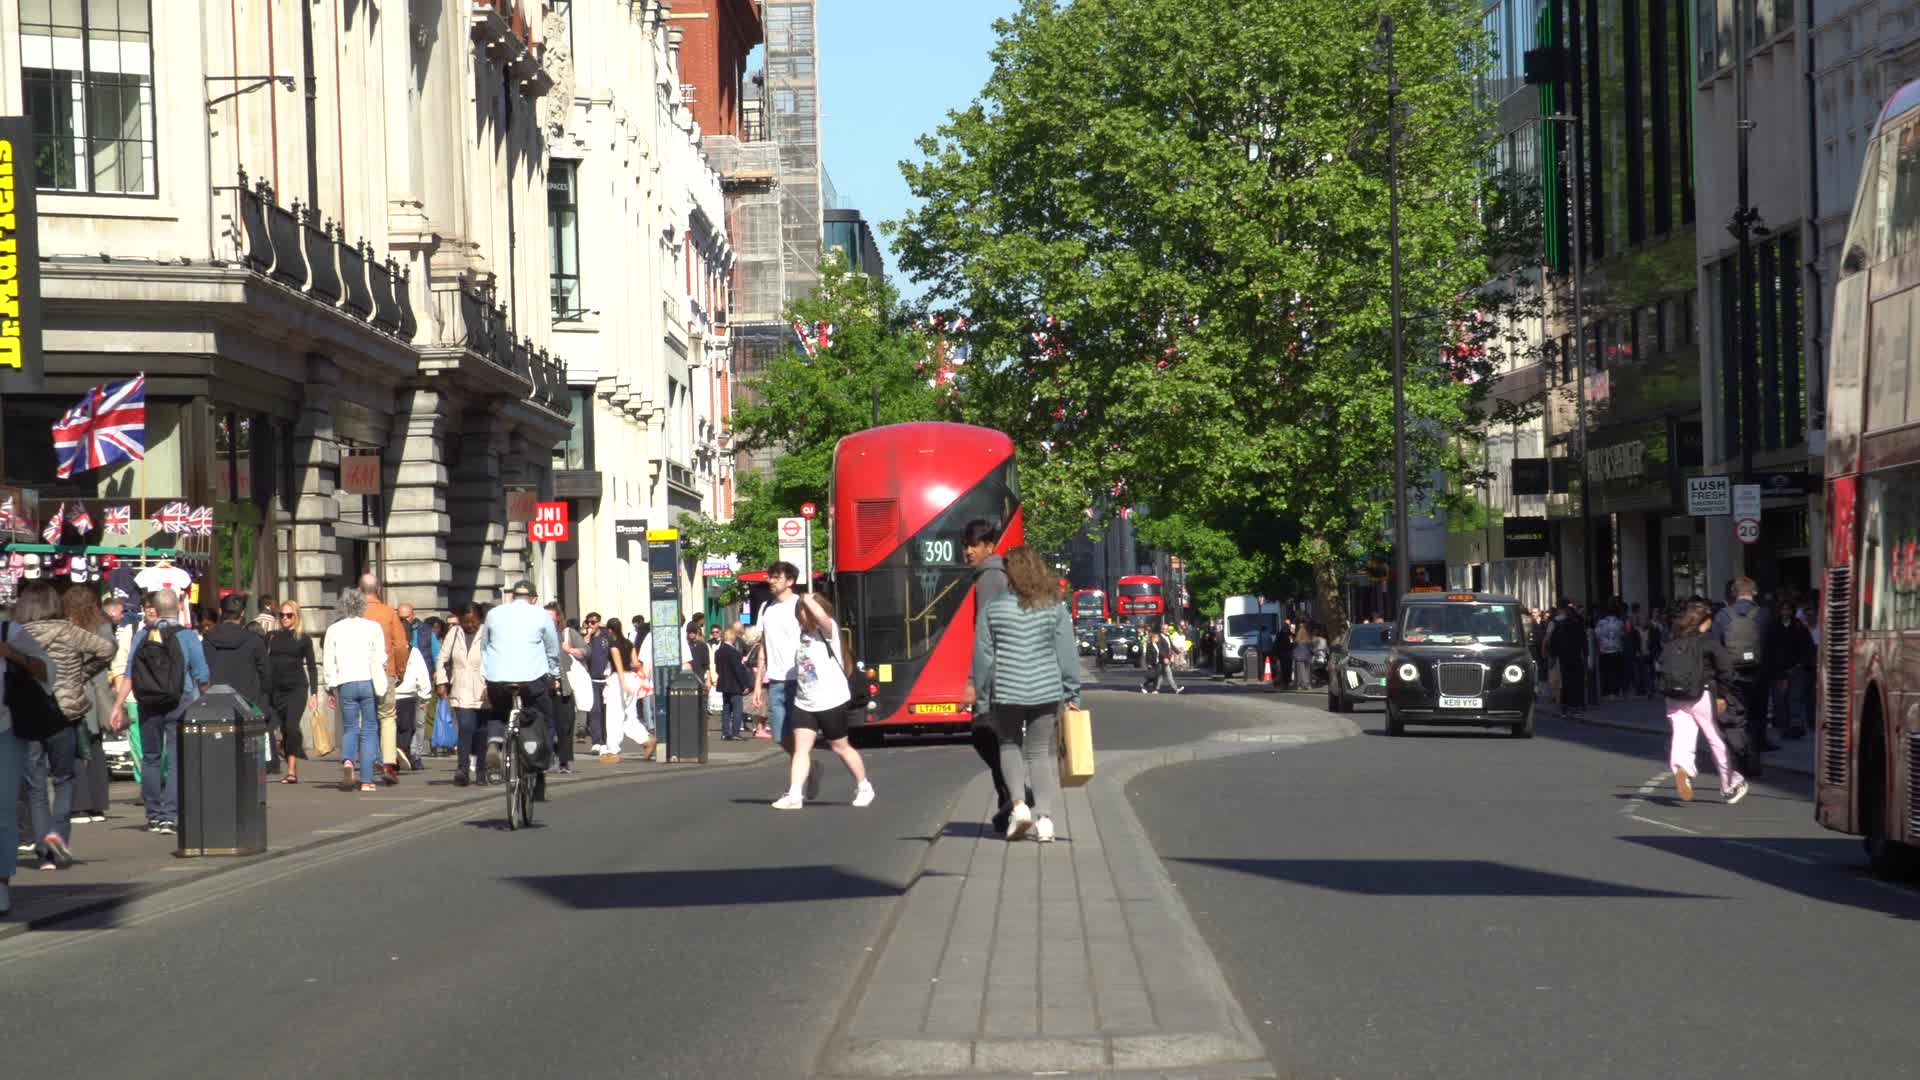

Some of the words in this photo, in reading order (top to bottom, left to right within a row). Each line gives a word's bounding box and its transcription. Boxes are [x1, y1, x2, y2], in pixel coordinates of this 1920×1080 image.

[1691, 480, 1726, 490] LUSH
[1691, 491, 1727, 500] FRESH
[533, 523, 564, 539] QLO
[1740, 526, 1759, 537] 20
[925, 540, 953, 562] 390
